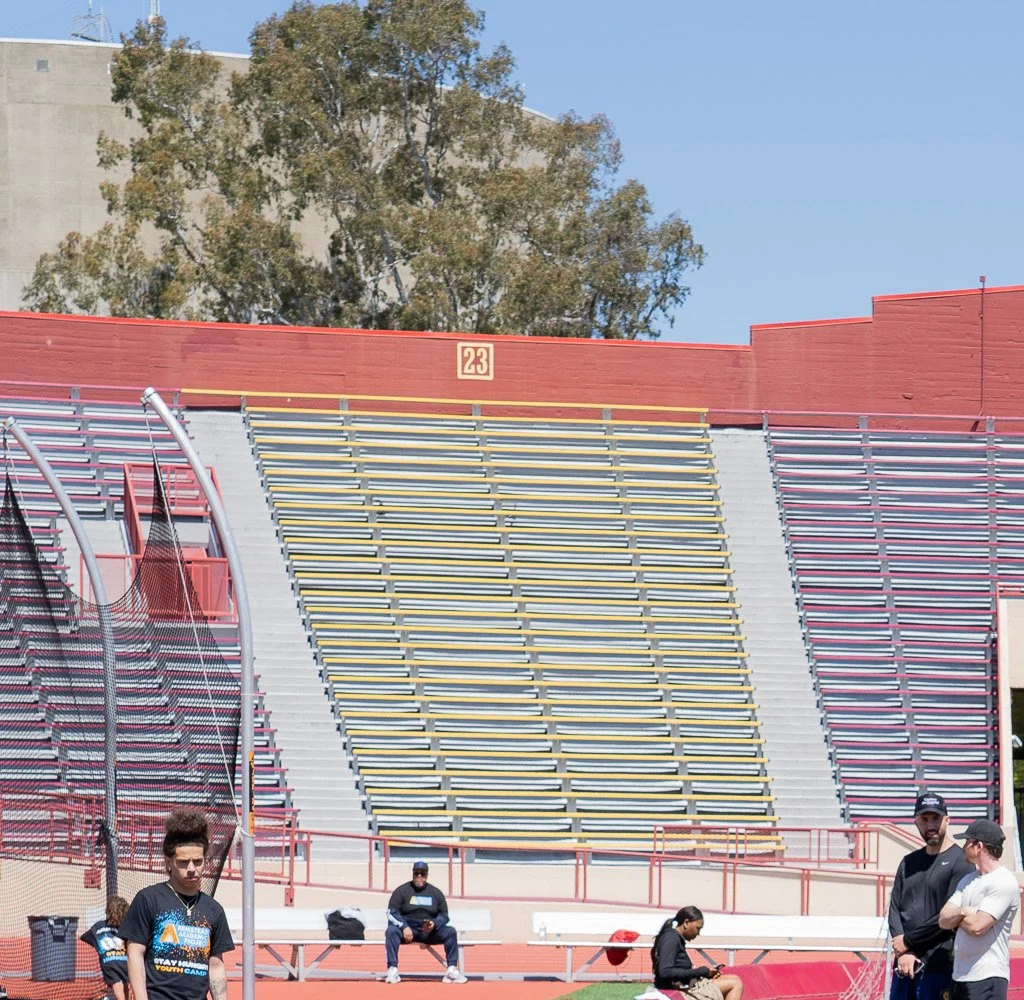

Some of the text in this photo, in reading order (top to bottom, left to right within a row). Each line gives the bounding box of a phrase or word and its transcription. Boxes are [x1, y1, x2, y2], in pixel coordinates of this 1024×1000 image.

[463, 347, 488, 375] 23
[154, 958, 178, 966] STAY
[155, 965, 207, 976] YOUTH CAMP
